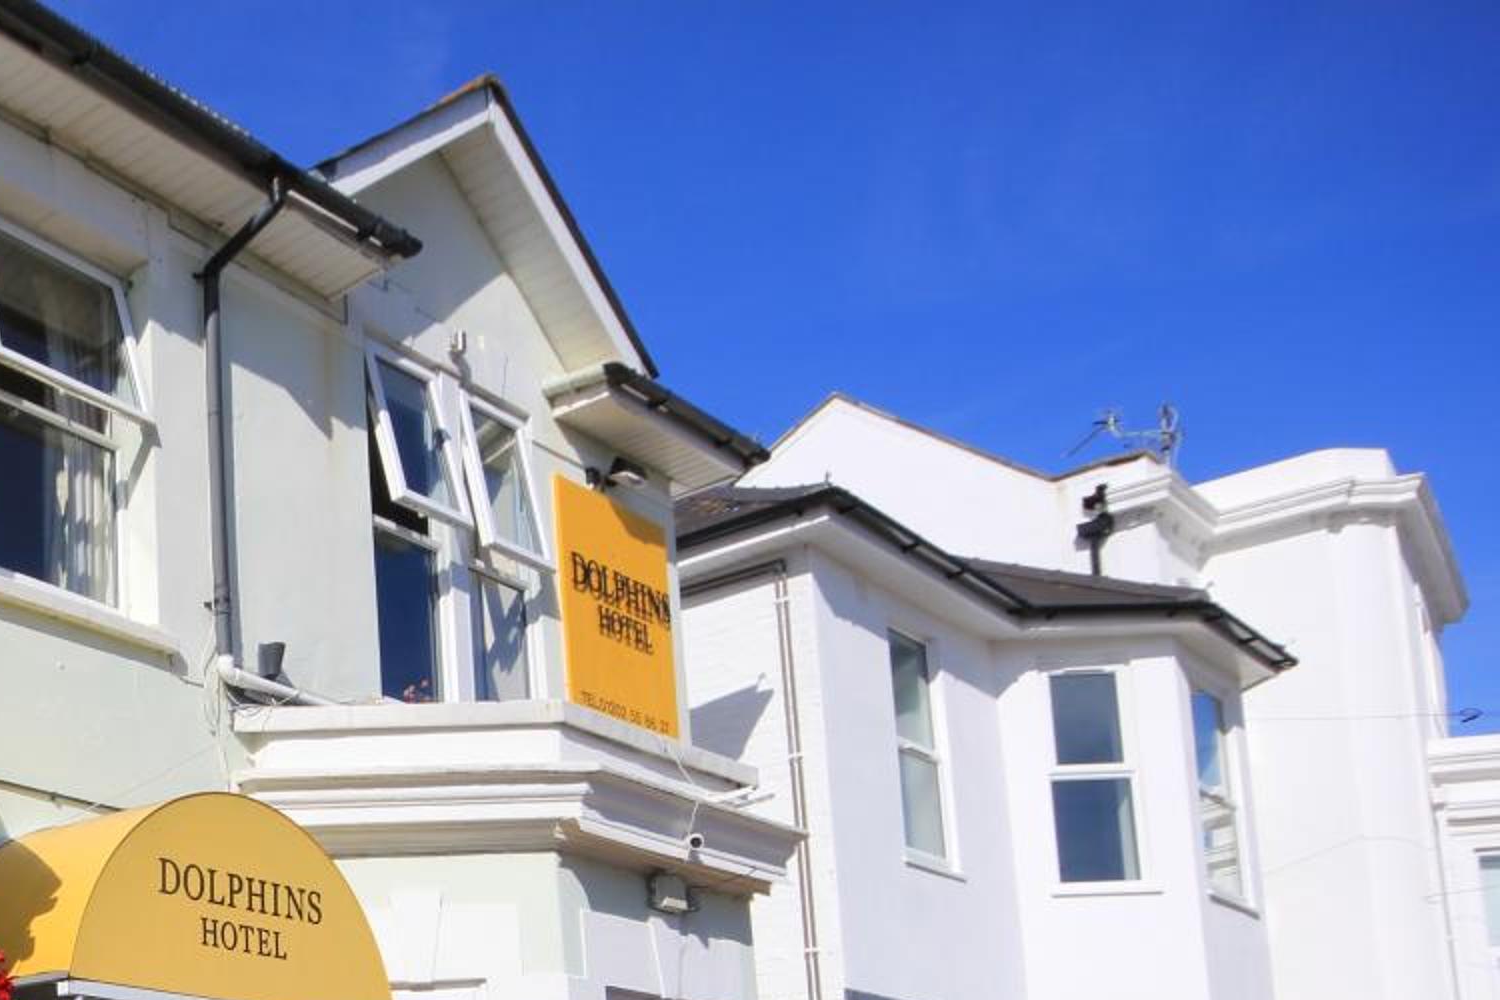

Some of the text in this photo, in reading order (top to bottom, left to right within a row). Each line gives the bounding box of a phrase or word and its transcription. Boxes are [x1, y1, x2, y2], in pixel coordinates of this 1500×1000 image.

[571, 551, 671, 626] DOLPHINS
[598, 604, 653, 654] HOTEL
[158, 857, 323, 925] DOLPHINS
[201, 917, 288, 960] HOTEL
